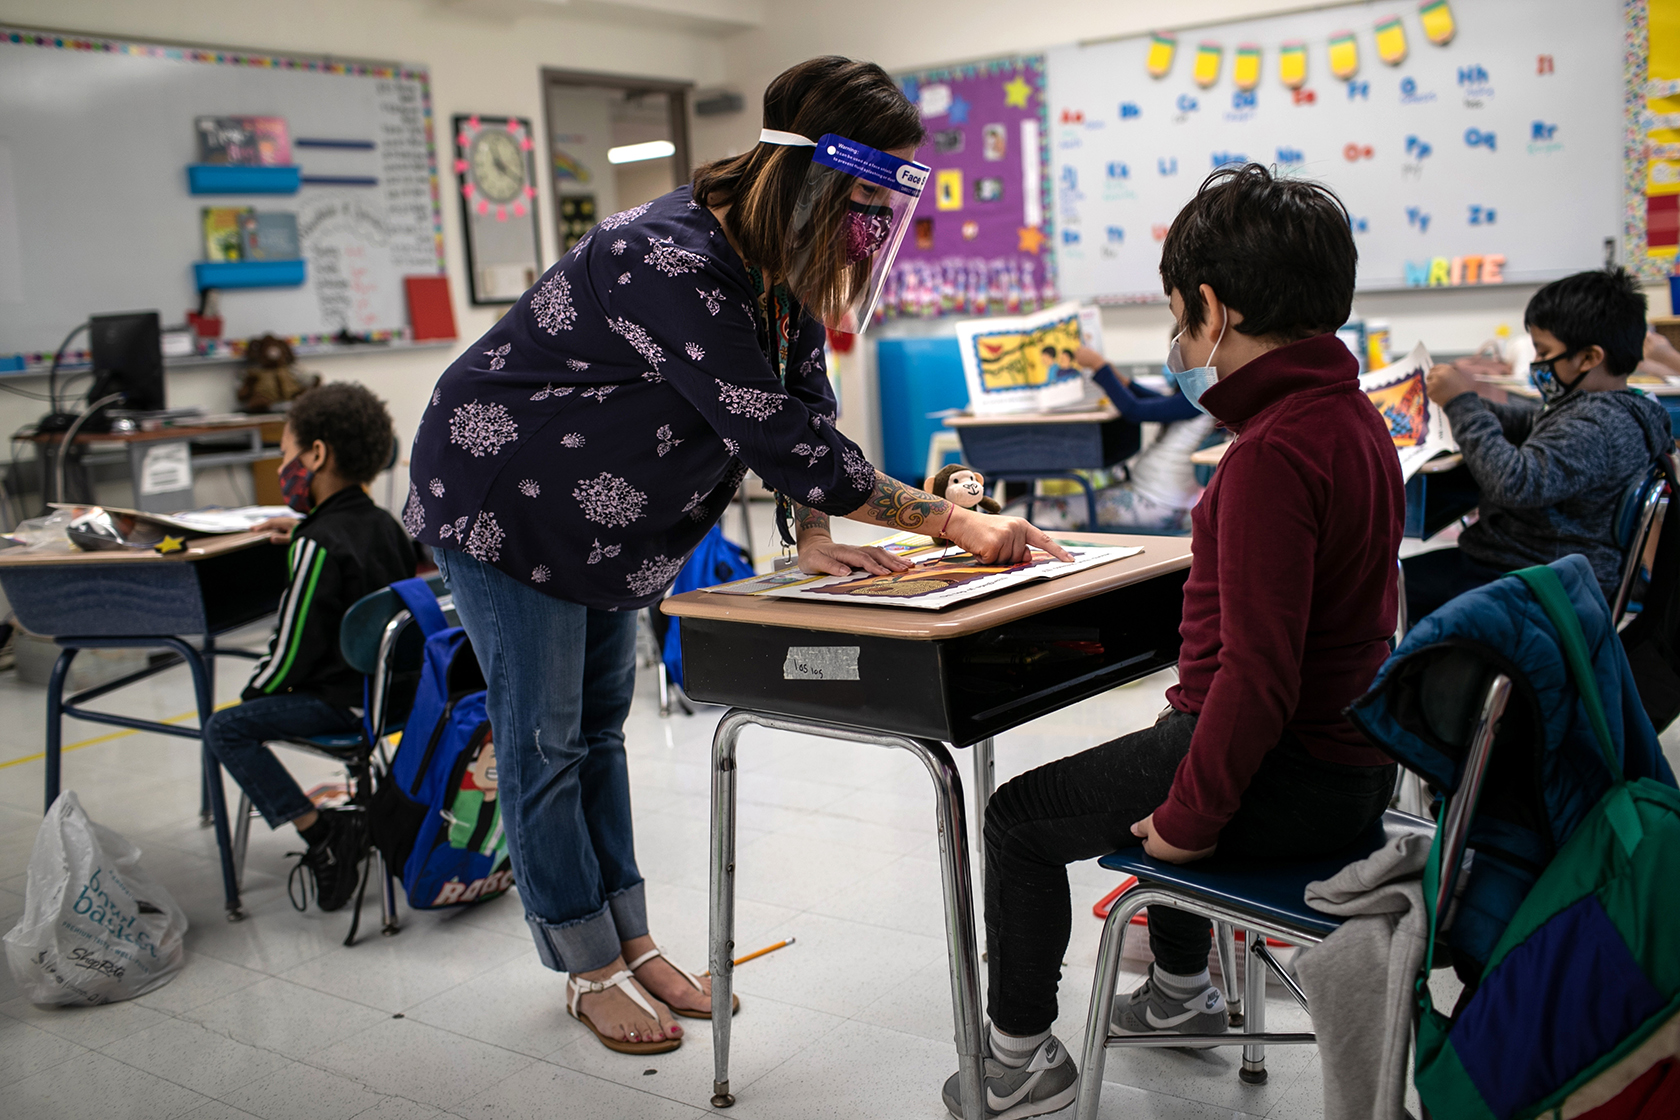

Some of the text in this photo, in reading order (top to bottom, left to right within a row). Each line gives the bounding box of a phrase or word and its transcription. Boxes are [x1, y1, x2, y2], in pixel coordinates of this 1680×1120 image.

[1531, 120, 1558, 140] Rr
[838, 143, 859, 155] Warning:
[901, 170, 921, 185] Face
[1404, 254, 1506, 287] WRITE
[62, 921, 93, 940] PREMIUM
[93, 936, 110, 951] TASTE
[66, 948, 127, 979] ShopRite
[1044, 1038, 1058, 1057] NIKE
